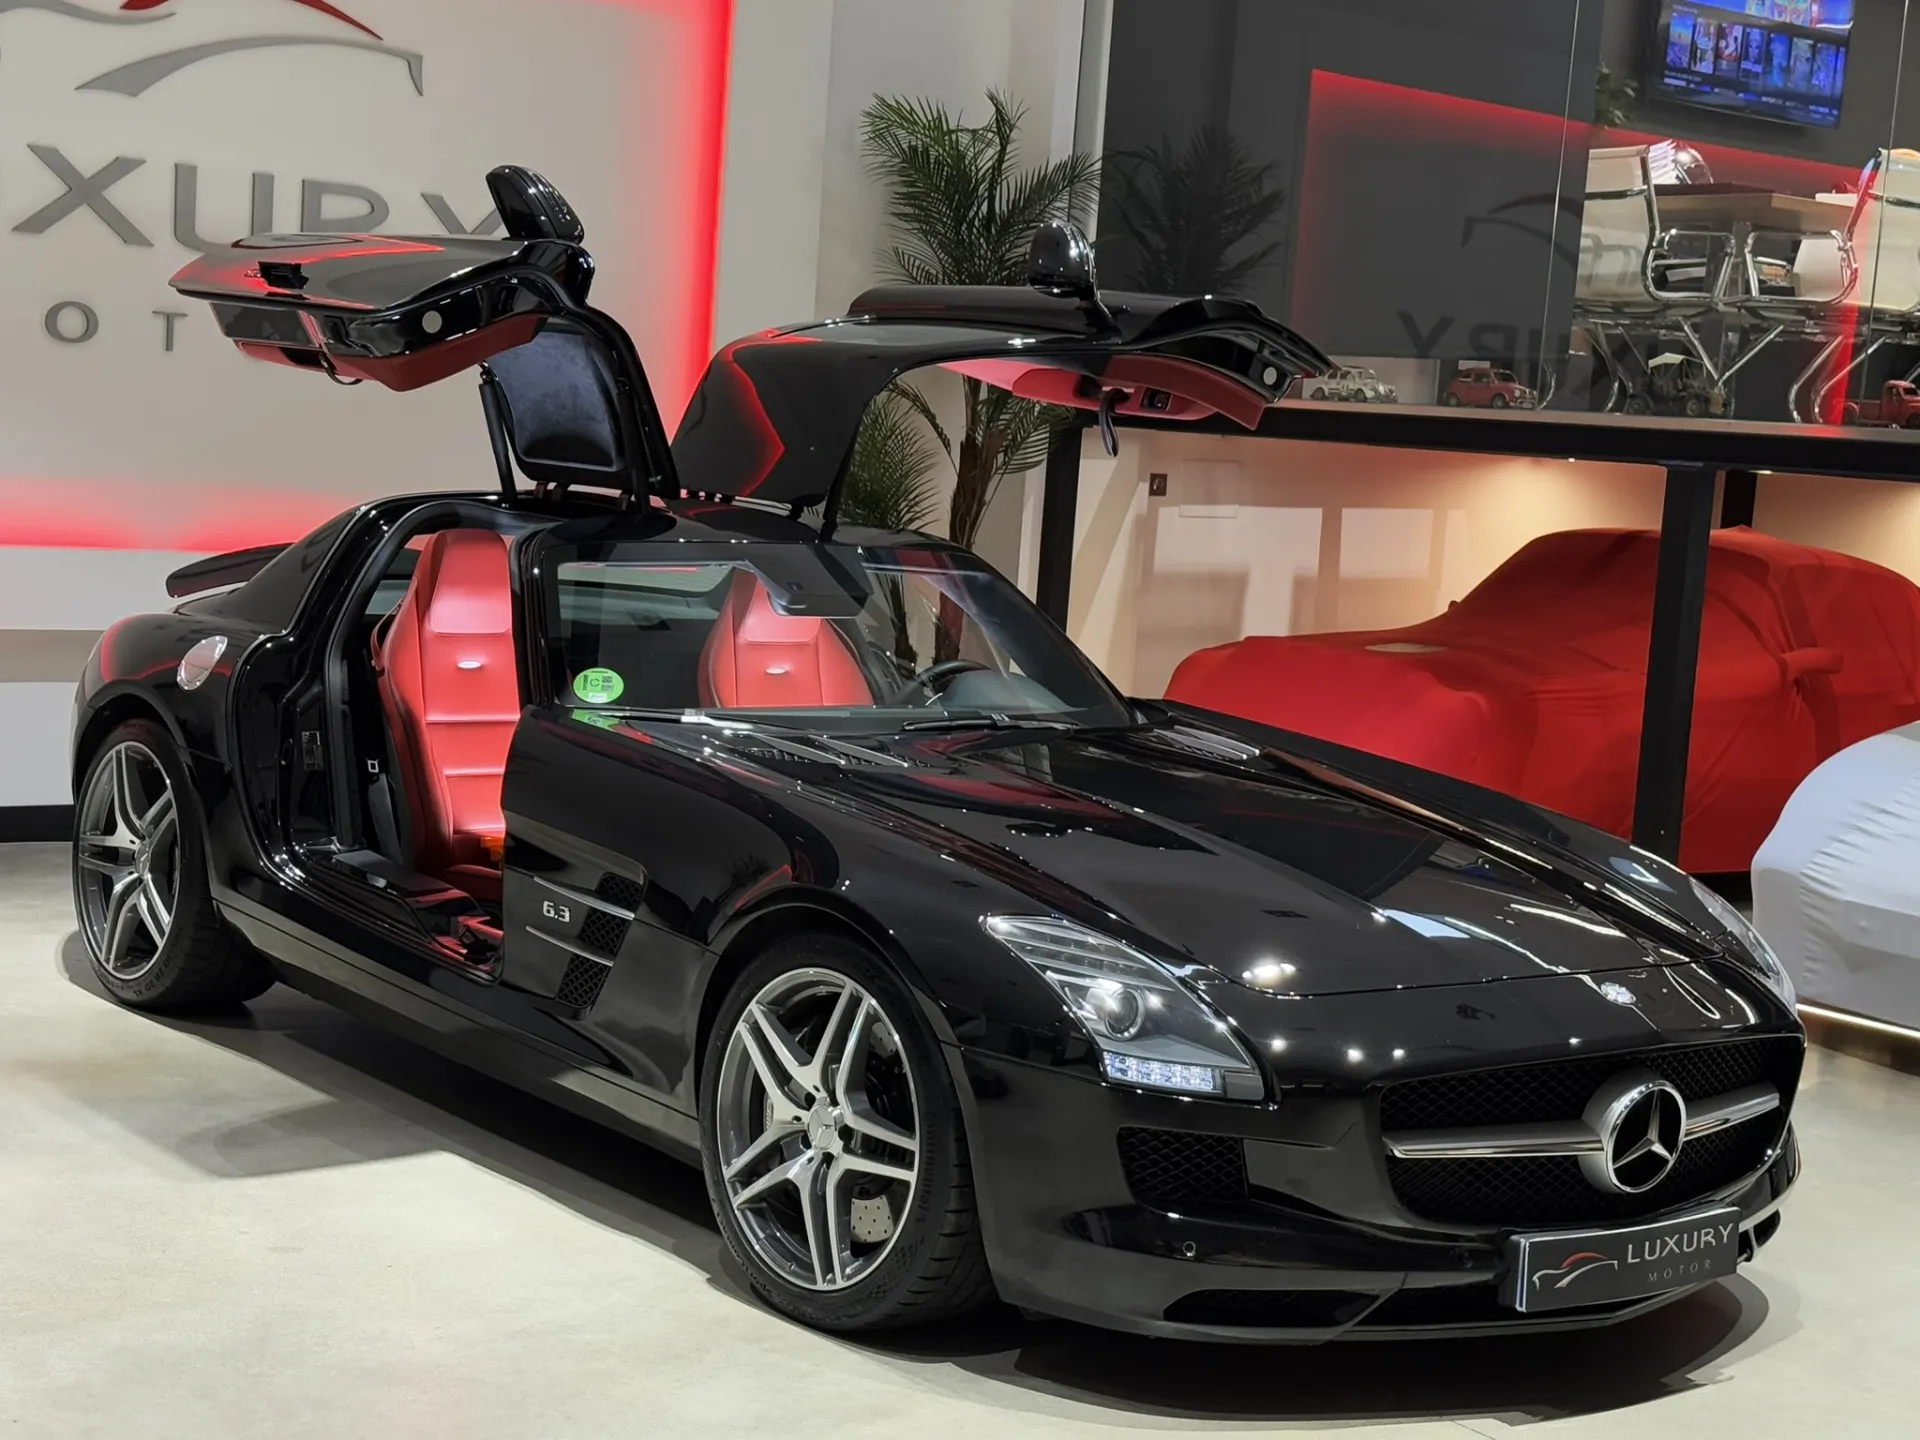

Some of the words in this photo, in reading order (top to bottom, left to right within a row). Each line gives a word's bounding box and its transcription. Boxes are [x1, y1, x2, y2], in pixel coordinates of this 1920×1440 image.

[542, 900, 570, 922] 6.3
[1627, 1224, 1733, 1263] LUXURY
[1648, 1260, 1711, 1282] MOTOR
